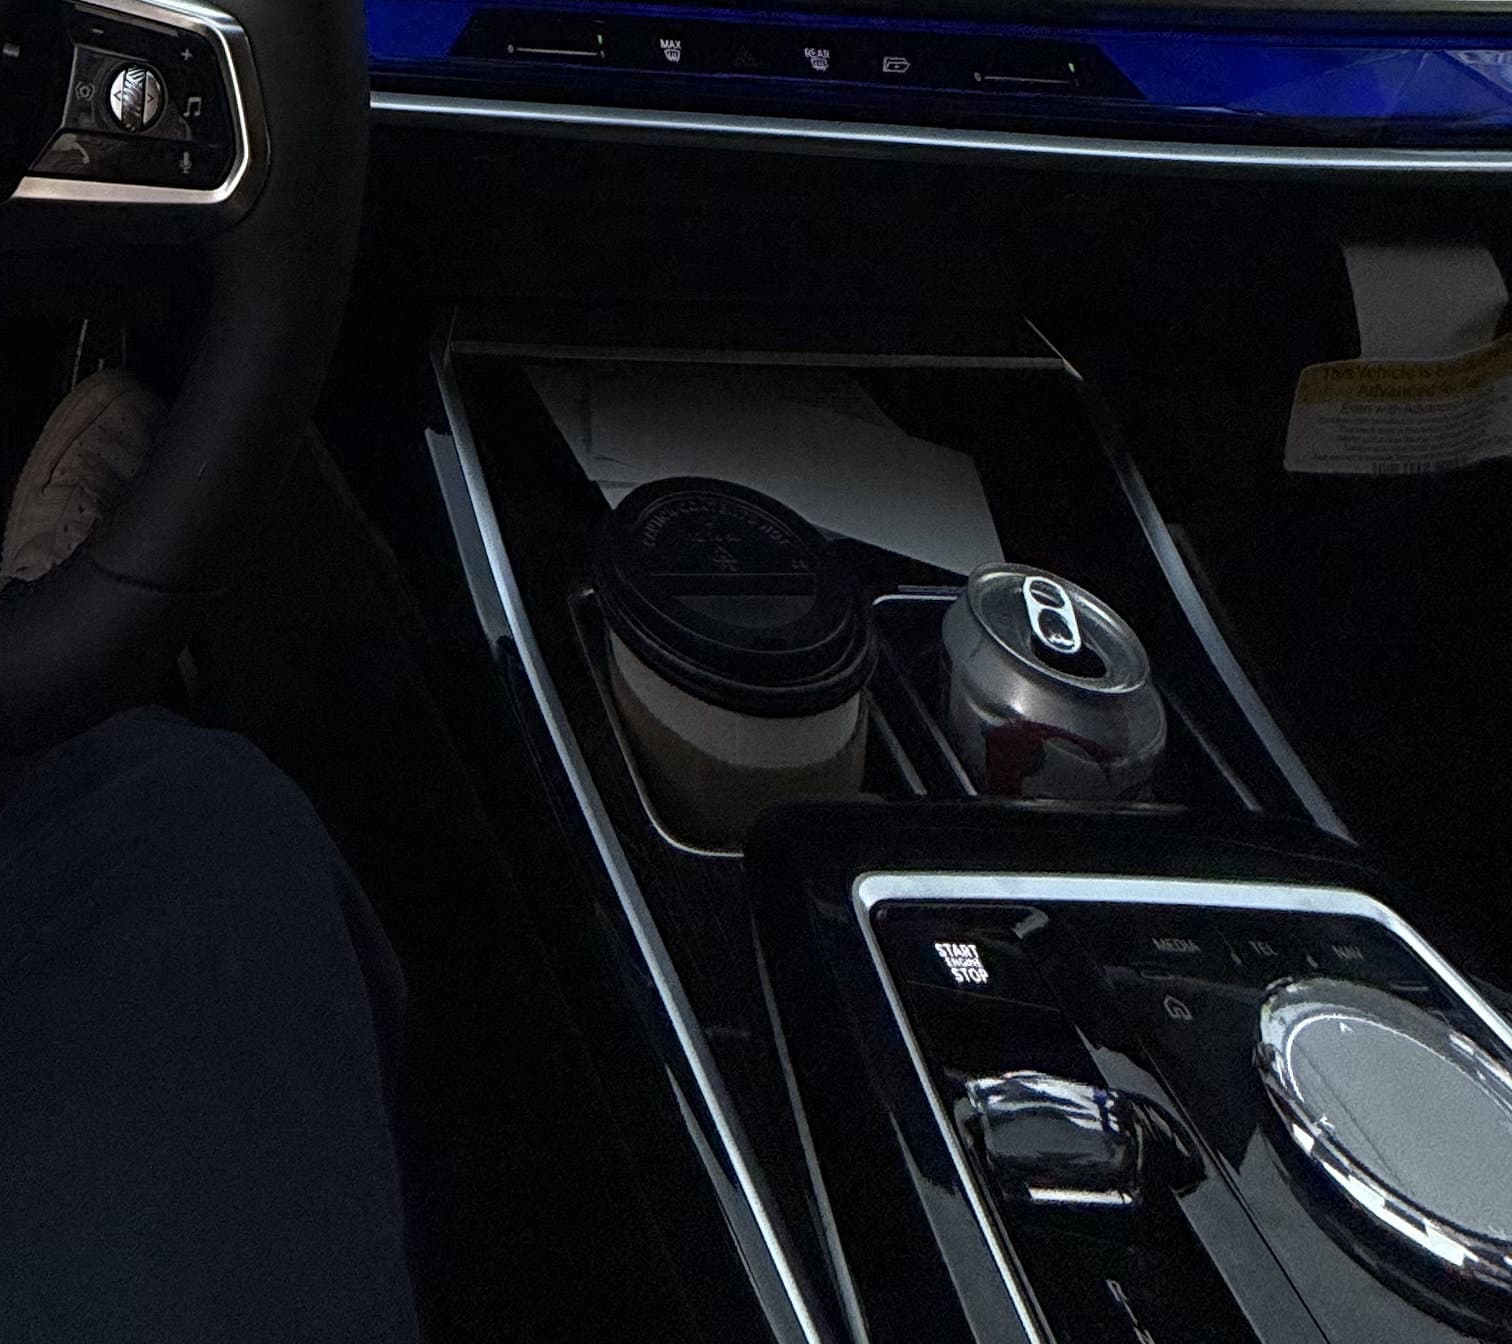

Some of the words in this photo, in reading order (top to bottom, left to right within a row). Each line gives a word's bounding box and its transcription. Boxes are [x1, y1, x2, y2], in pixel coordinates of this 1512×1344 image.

[659, 38, 681, 49] MAX
[804, 47, 830, 58] REAR
[934, 943, 979, 958] START
[1151, 937, 1201, 953] MEDIA
[951, 967, 988, 984] STOP
